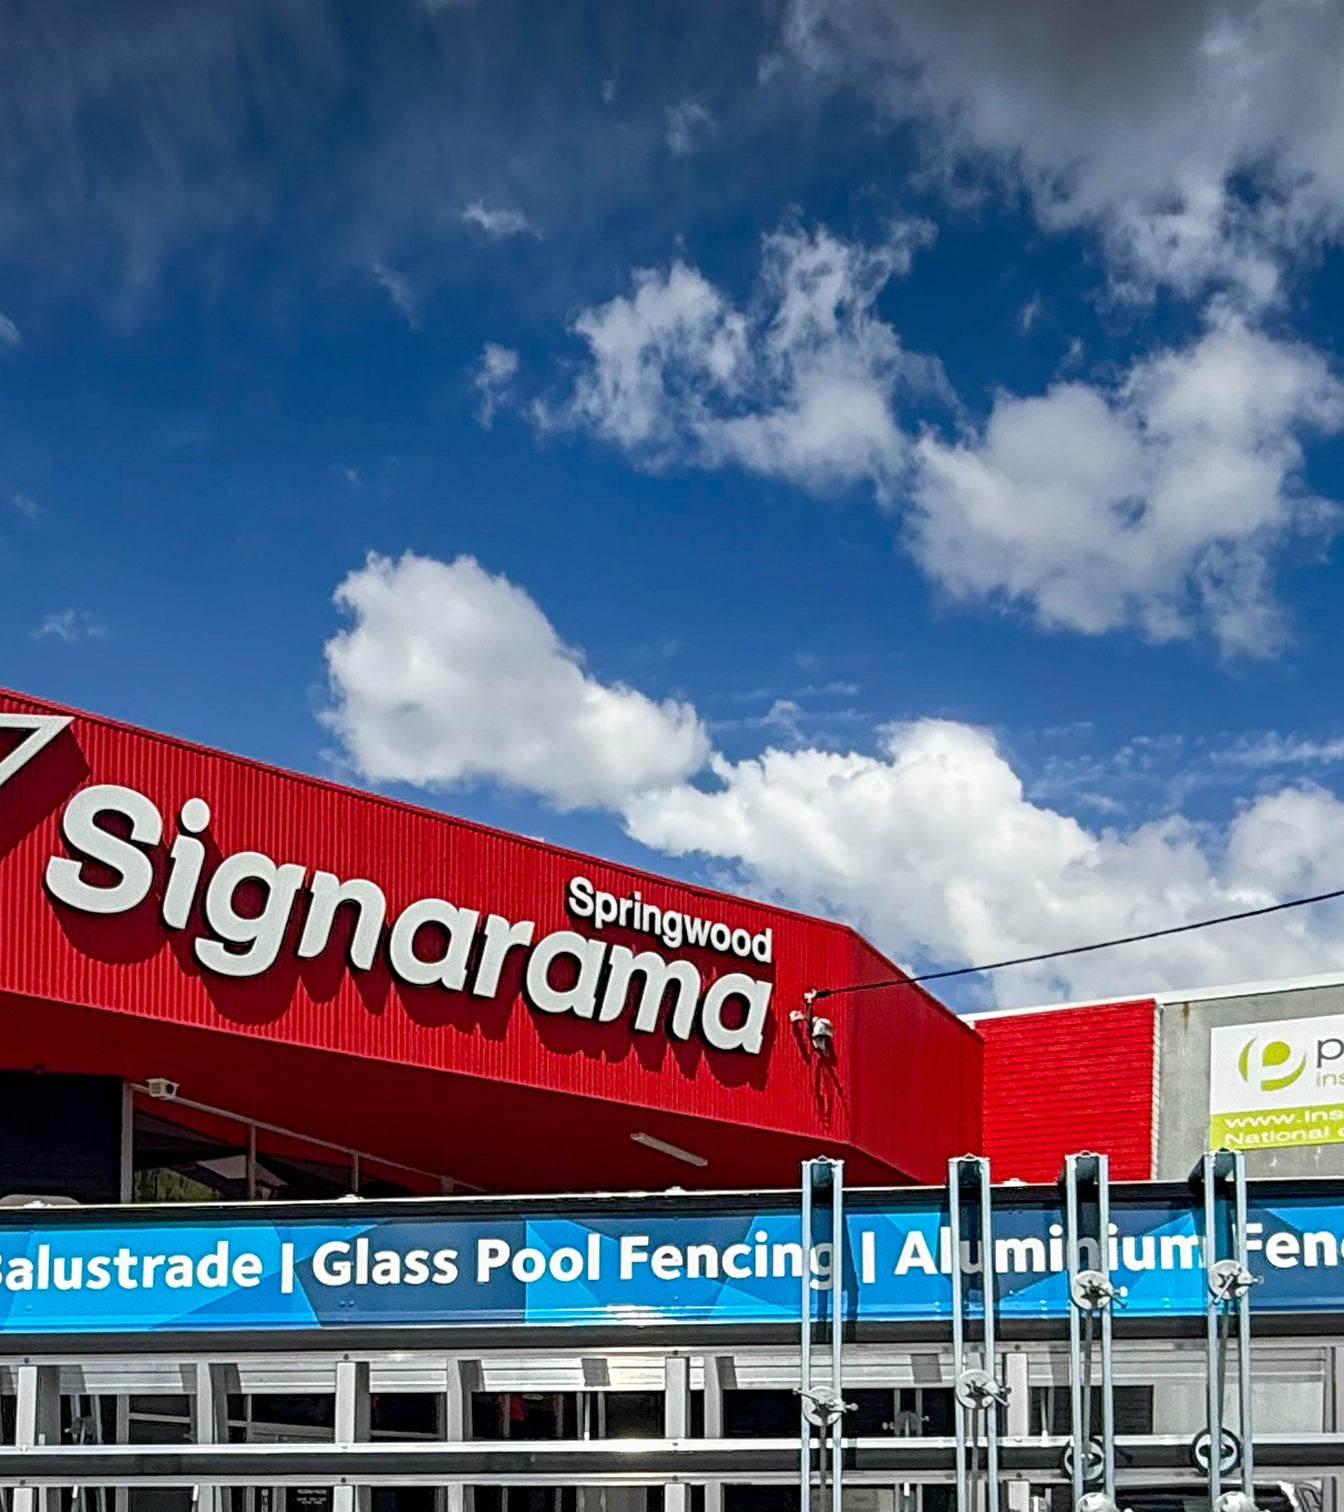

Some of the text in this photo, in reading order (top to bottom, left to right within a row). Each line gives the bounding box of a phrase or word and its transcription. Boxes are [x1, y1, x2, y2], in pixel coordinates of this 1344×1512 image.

[44, 784, 773, 1057] Signarama
[567, 876, 773, 964] Springwood
[1224, 1125, 1330, 1146] National
[313, 1239, 458, 1289] Glass
[476, 1235, 601, 1284] Pool
[619, 1232, 834, 1291] Fencing
